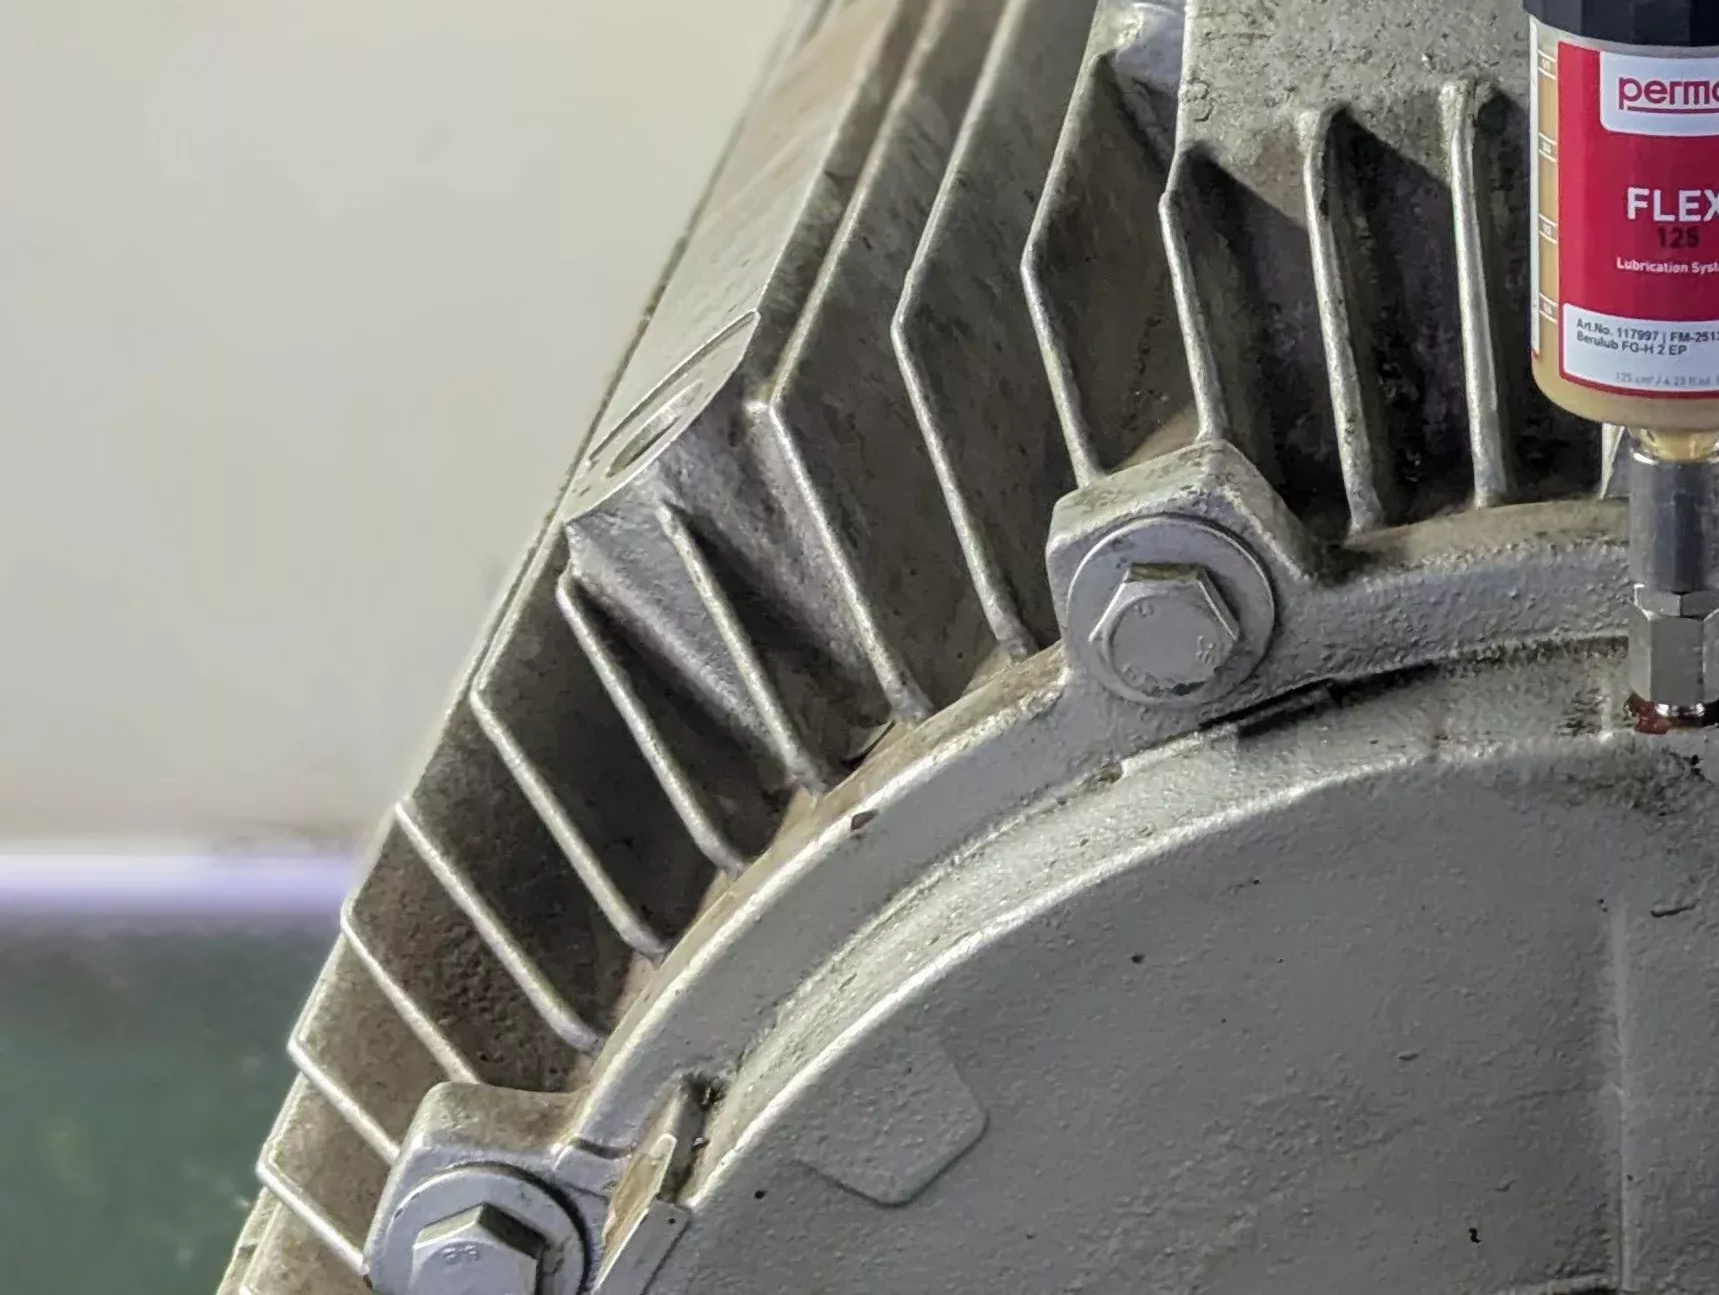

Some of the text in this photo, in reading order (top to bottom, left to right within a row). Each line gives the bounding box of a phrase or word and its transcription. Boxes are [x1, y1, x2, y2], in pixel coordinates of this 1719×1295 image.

[1658, 226, 1700, 248] 125
[1616, 257, 1688, 273] Lubrication
[1657, 345, 1666, 355] 2
[1669, 345, 1688, 356] EP
